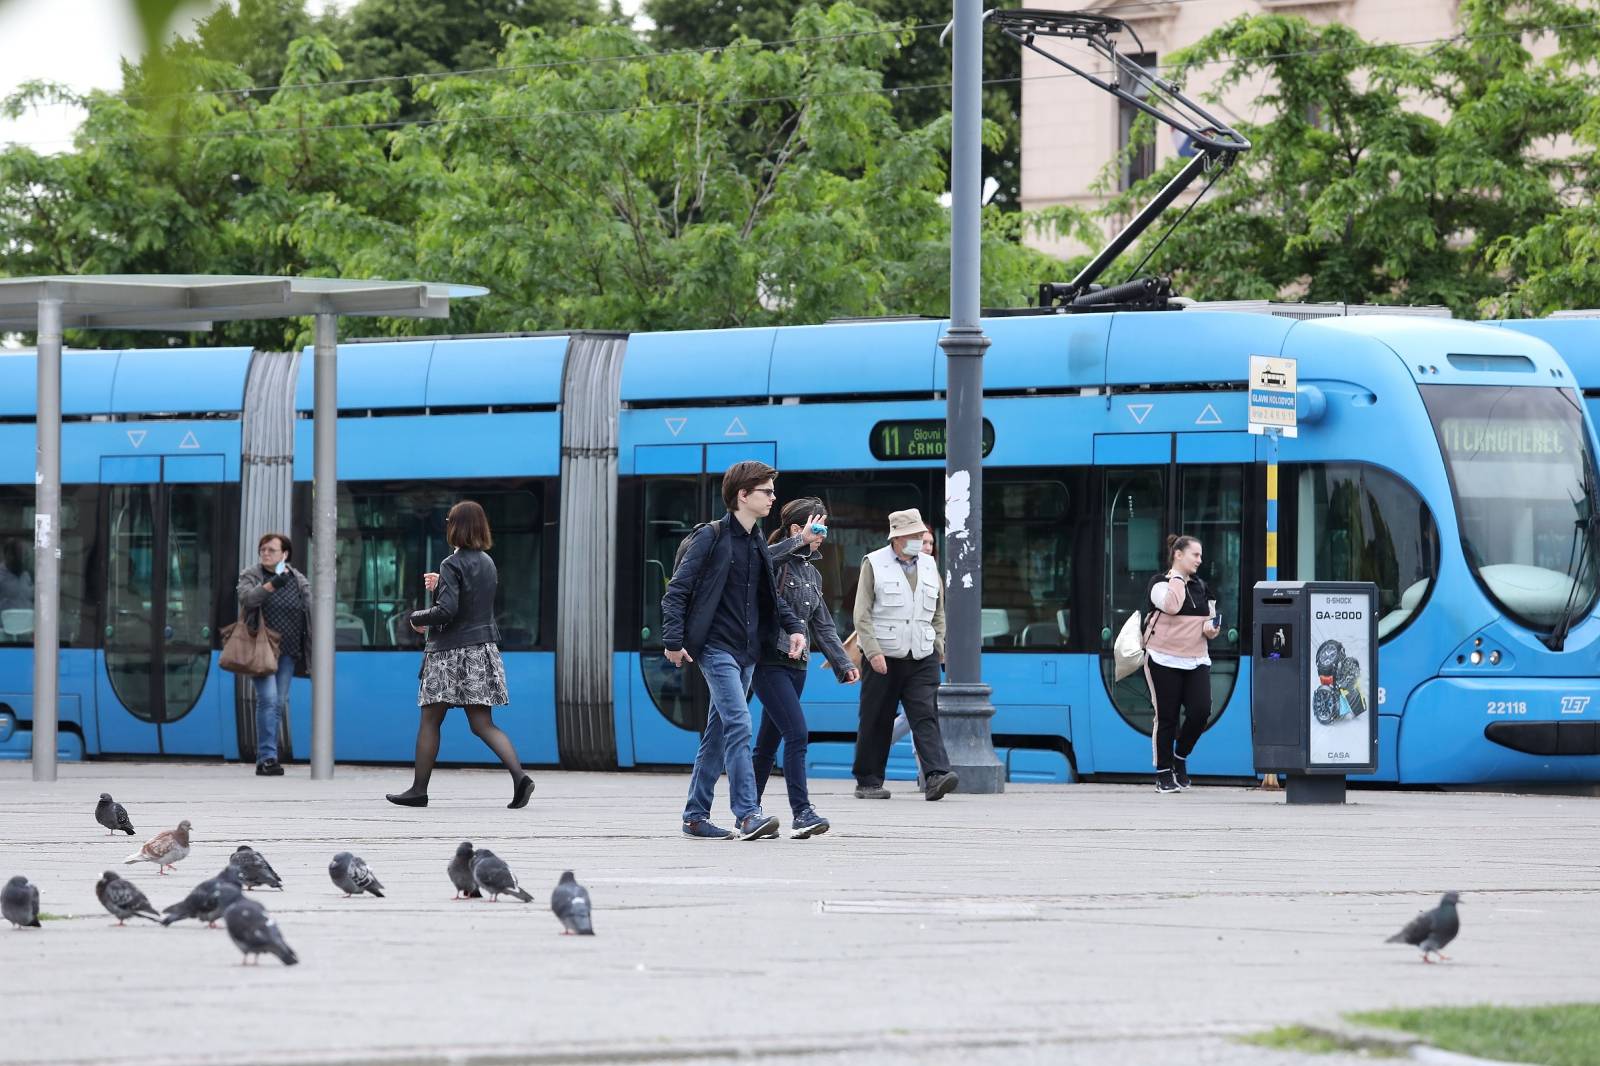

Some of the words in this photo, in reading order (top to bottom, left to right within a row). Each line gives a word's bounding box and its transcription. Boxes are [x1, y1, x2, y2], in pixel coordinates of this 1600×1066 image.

[882, 426, 900, 456] 11
[913, 428, 941, 441] Glavni
[1326, 597, 1353, 605] G-SHOCK
[1315, 611, 1362, 620] GA-2000
[1487, 701, 1527, 714] 22118
[1560, 696, 1591, 714] ZET
